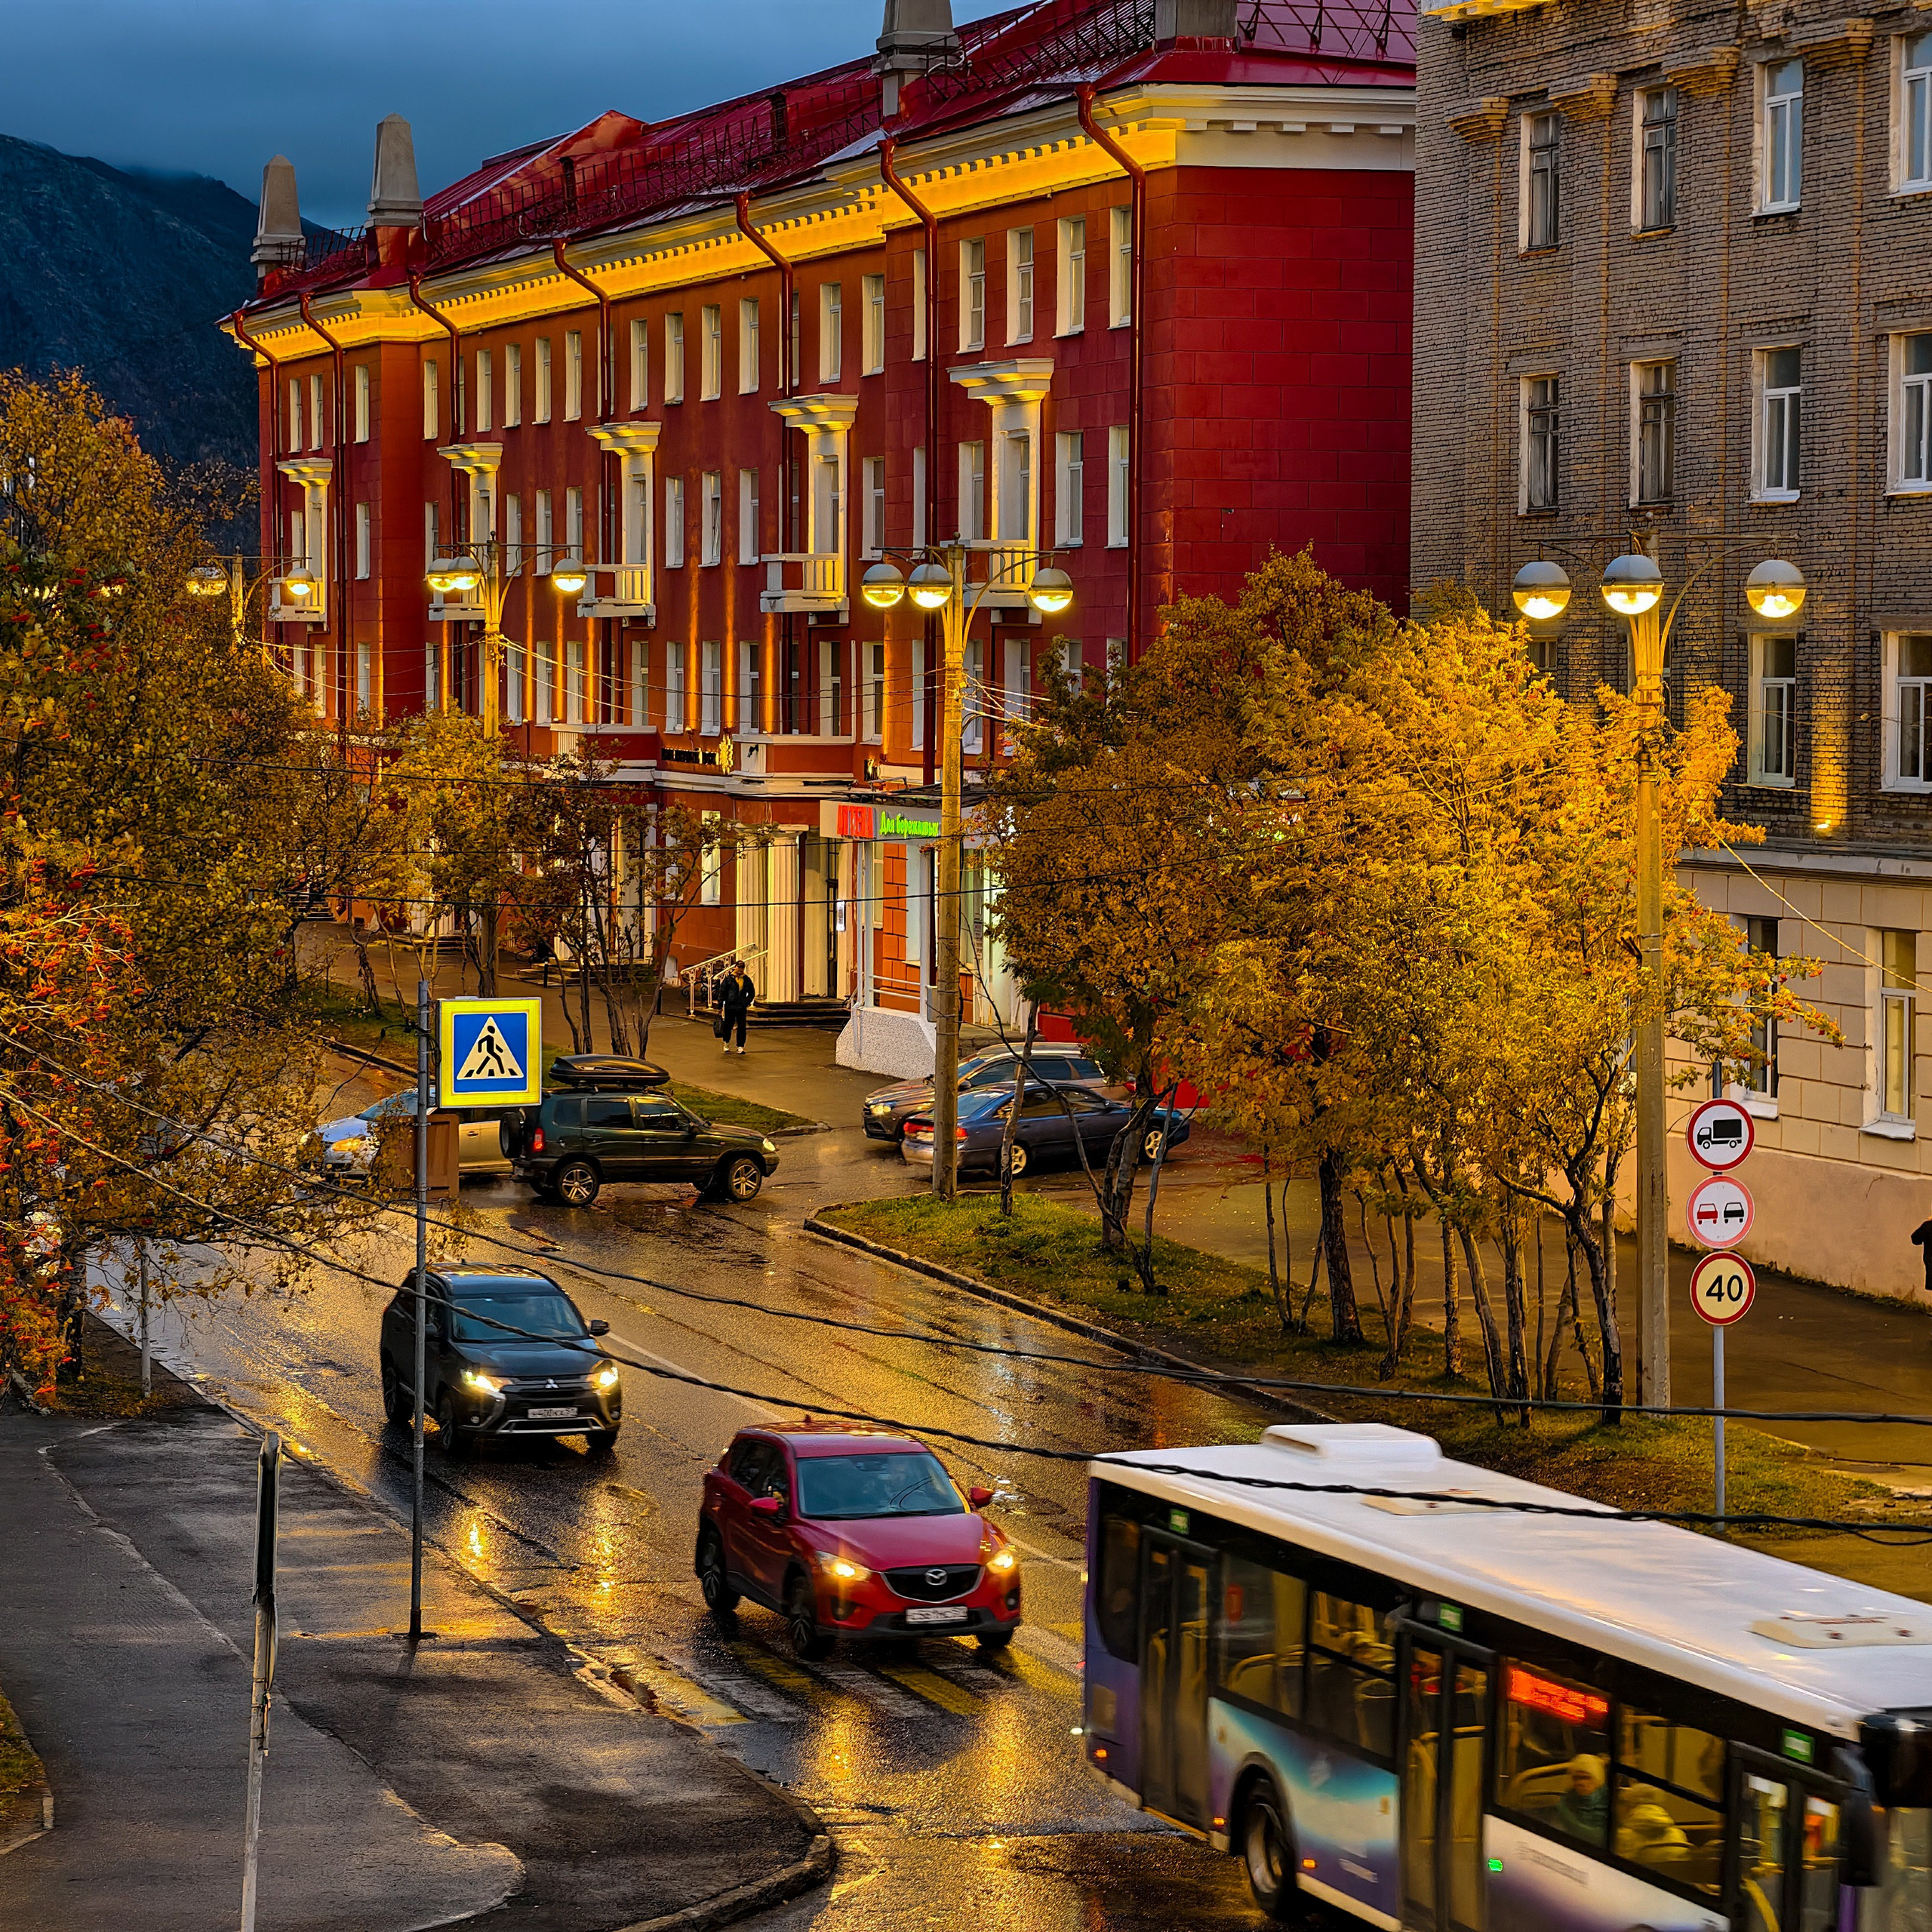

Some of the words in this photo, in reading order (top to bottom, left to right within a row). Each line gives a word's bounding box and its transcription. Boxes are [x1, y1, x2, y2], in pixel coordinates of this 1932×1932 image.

[879, 811, 895, 835] Для
[896, 813, 939, 839] бережливых
[1706, 1275, 1743, 1303] 40
